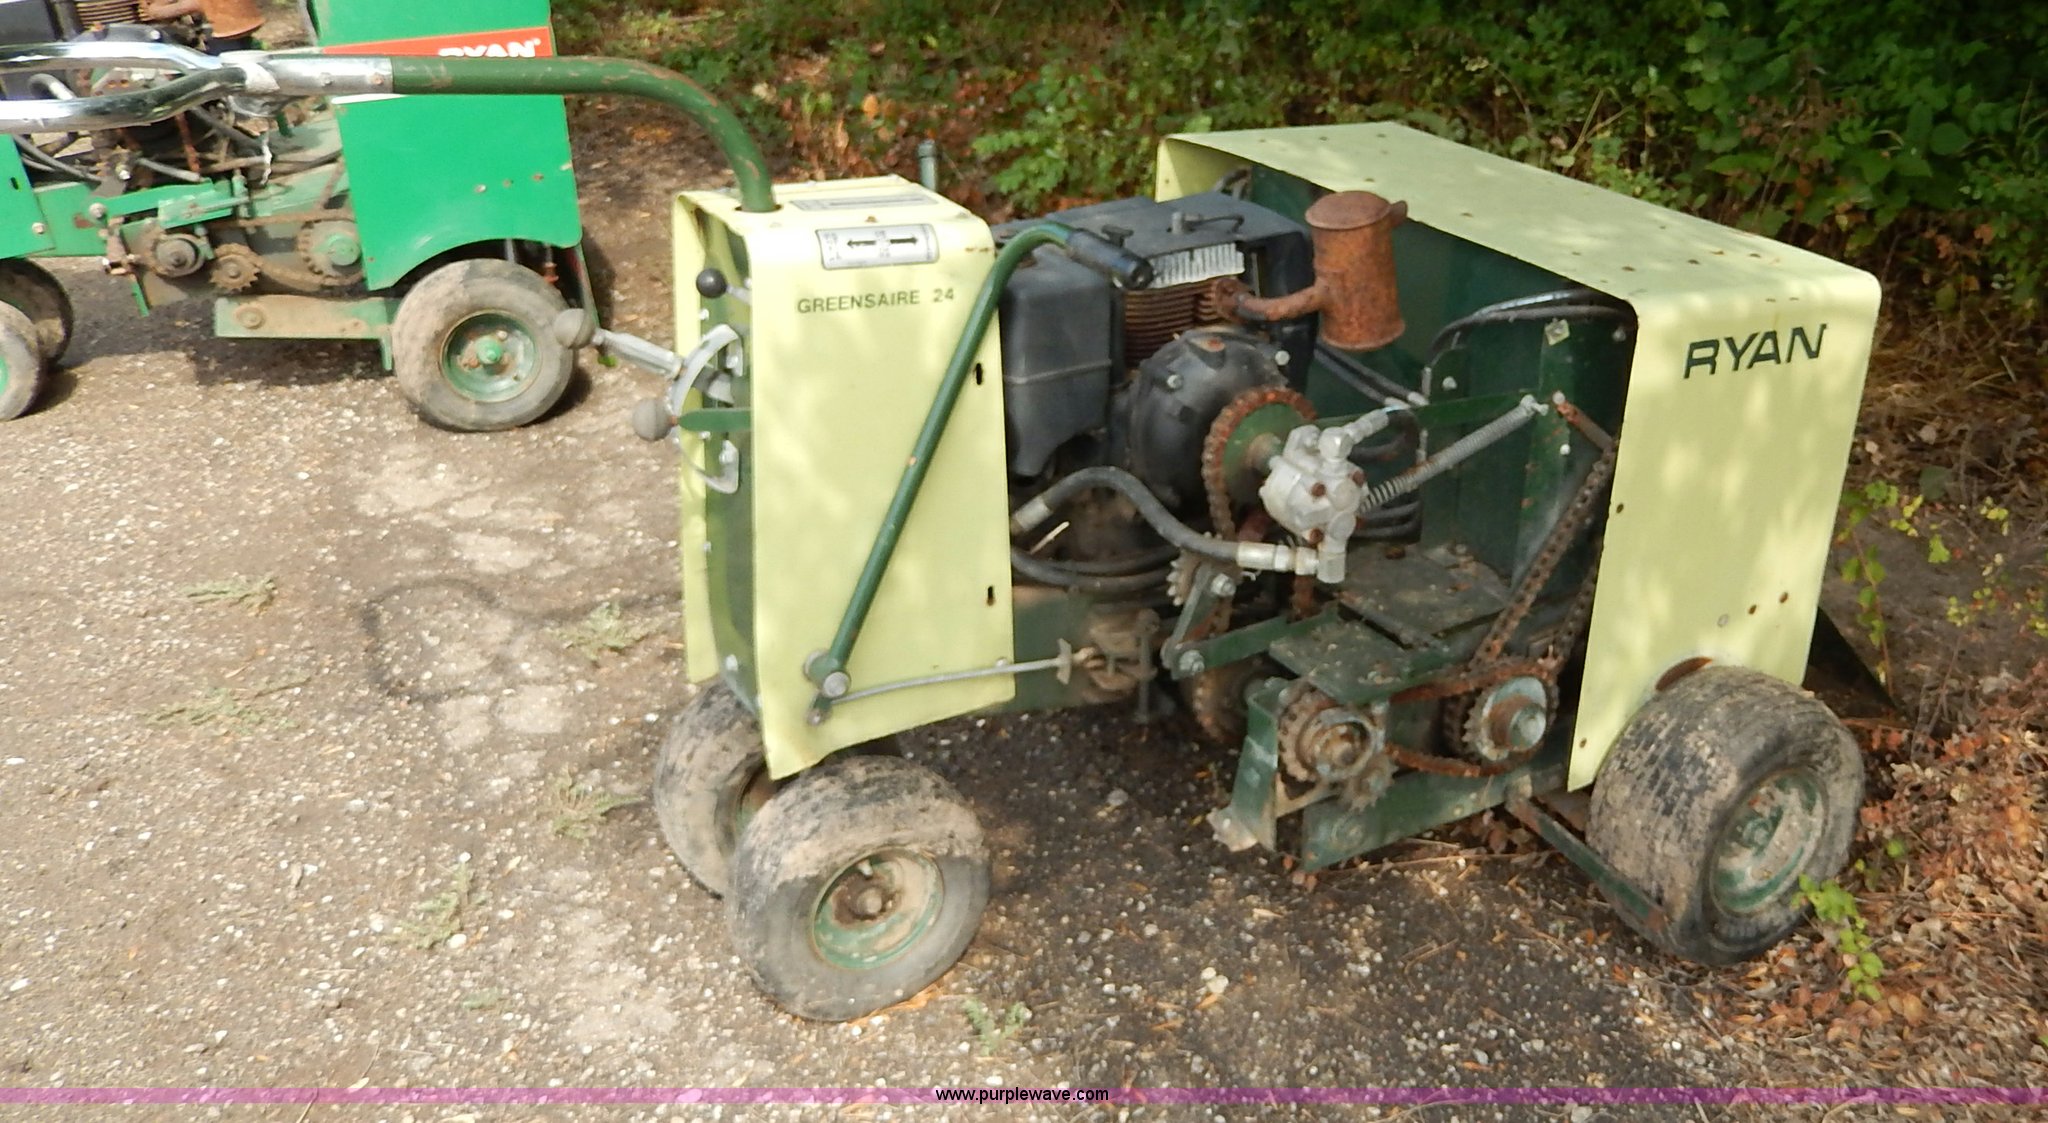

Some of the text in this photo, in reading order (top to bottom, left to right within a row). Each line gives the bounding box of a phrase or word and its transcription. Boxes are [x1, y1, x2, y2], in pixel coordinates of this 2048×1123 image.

[797, 288, 955, 314] GREENSAIRE 24
[1683, 323, 1827, 379] RYAN
